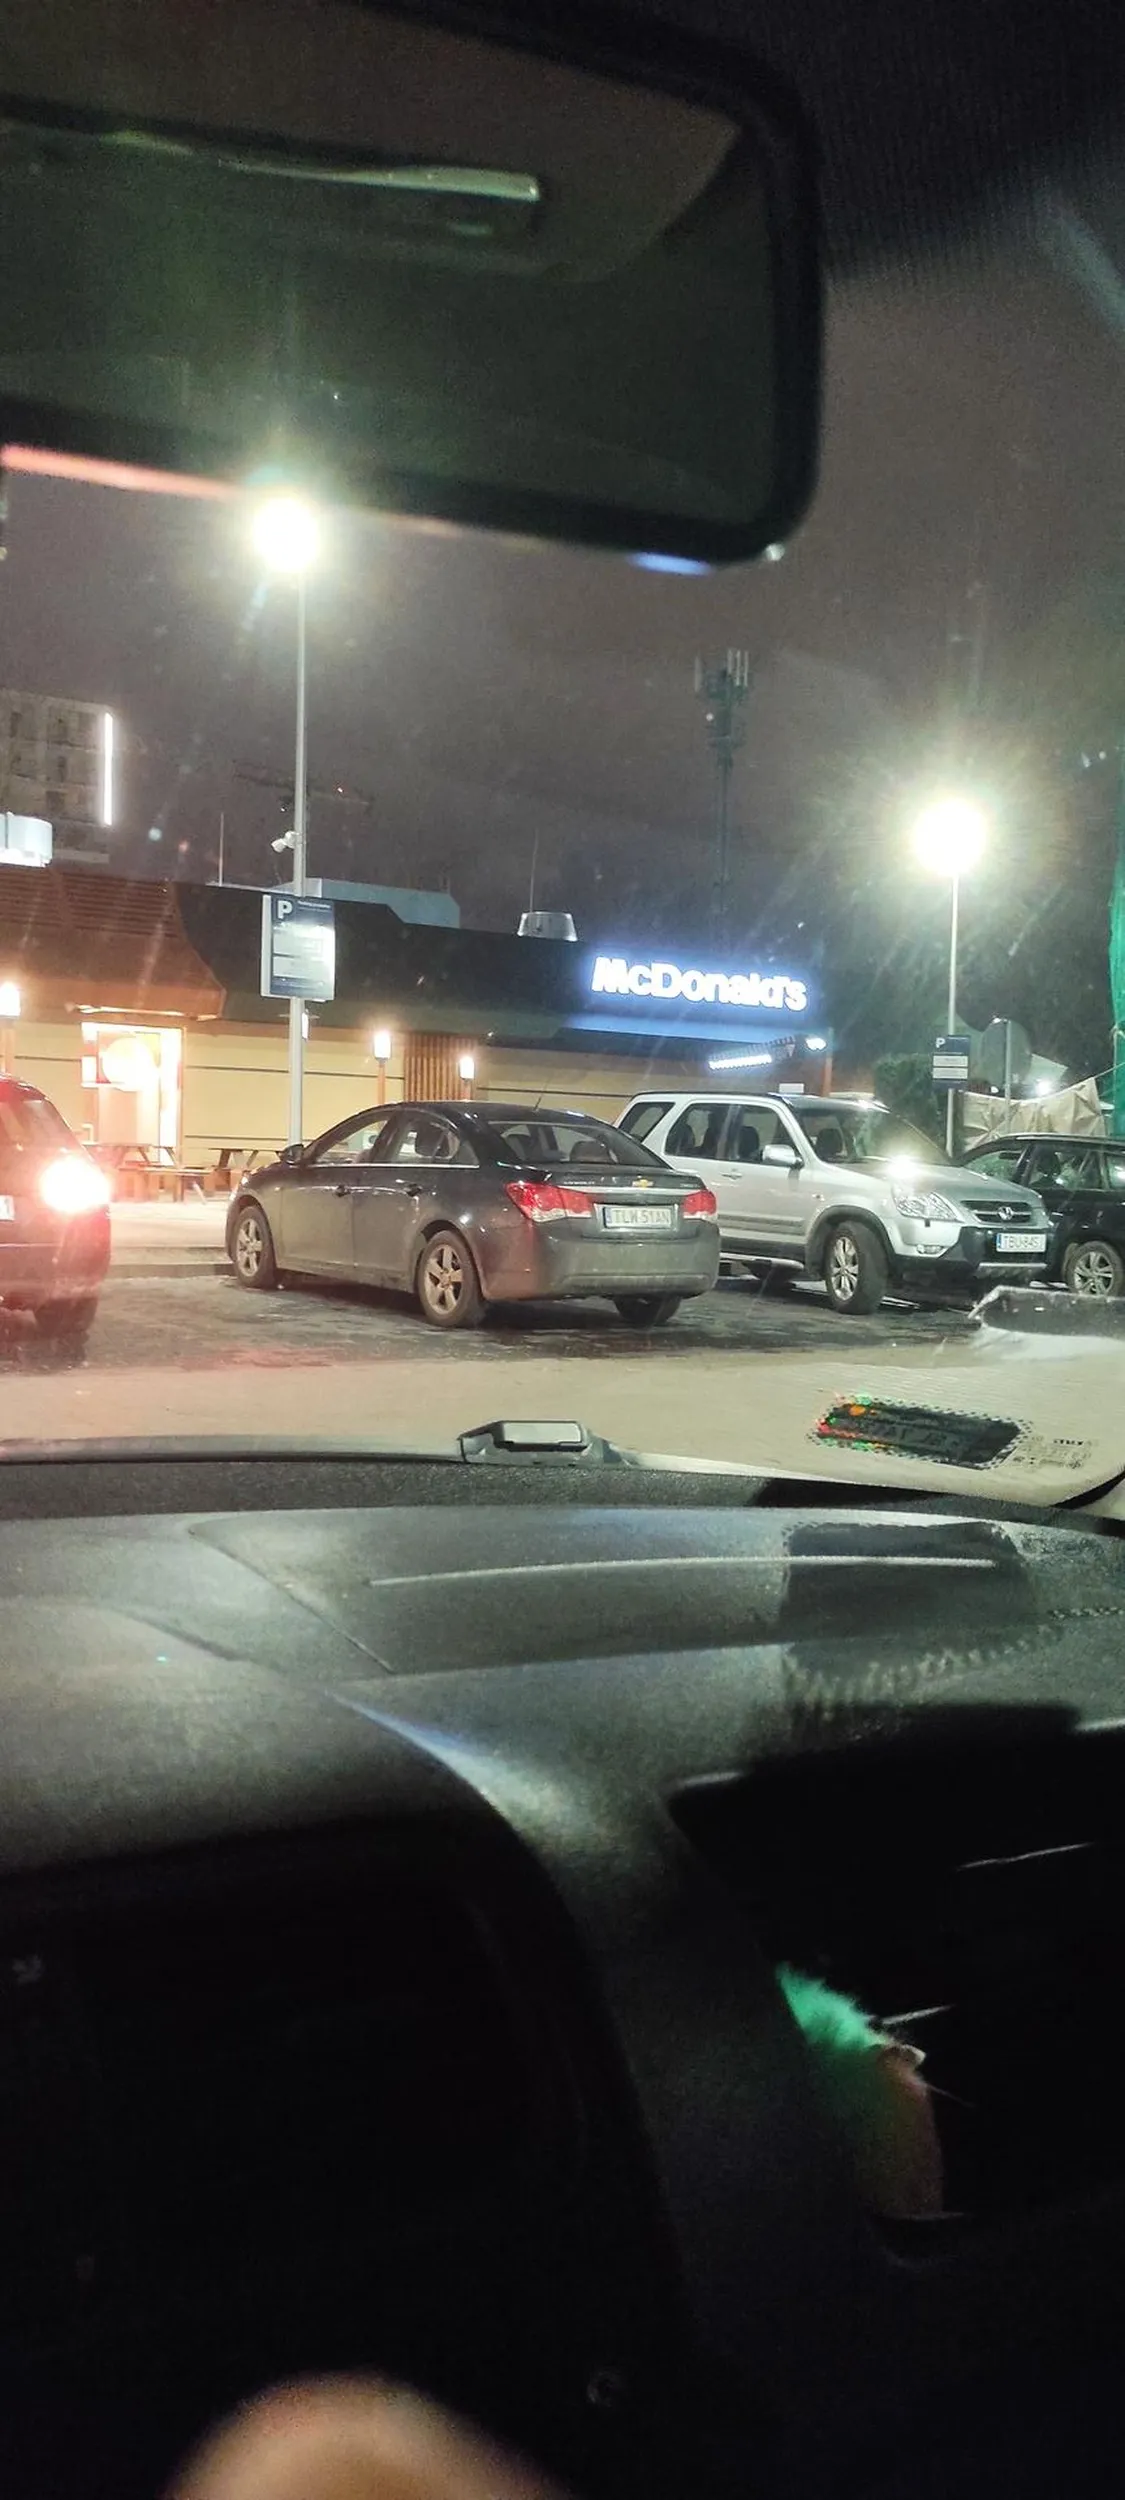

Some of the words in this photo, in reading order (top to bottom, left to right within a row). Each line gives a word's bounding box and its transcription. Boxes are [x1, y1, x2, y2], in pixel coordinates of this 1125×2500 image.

[277, 900, 293, 919] P
[591, 956, 807, 1011] McDonald's
[935, 1037, 946, 1048] P
